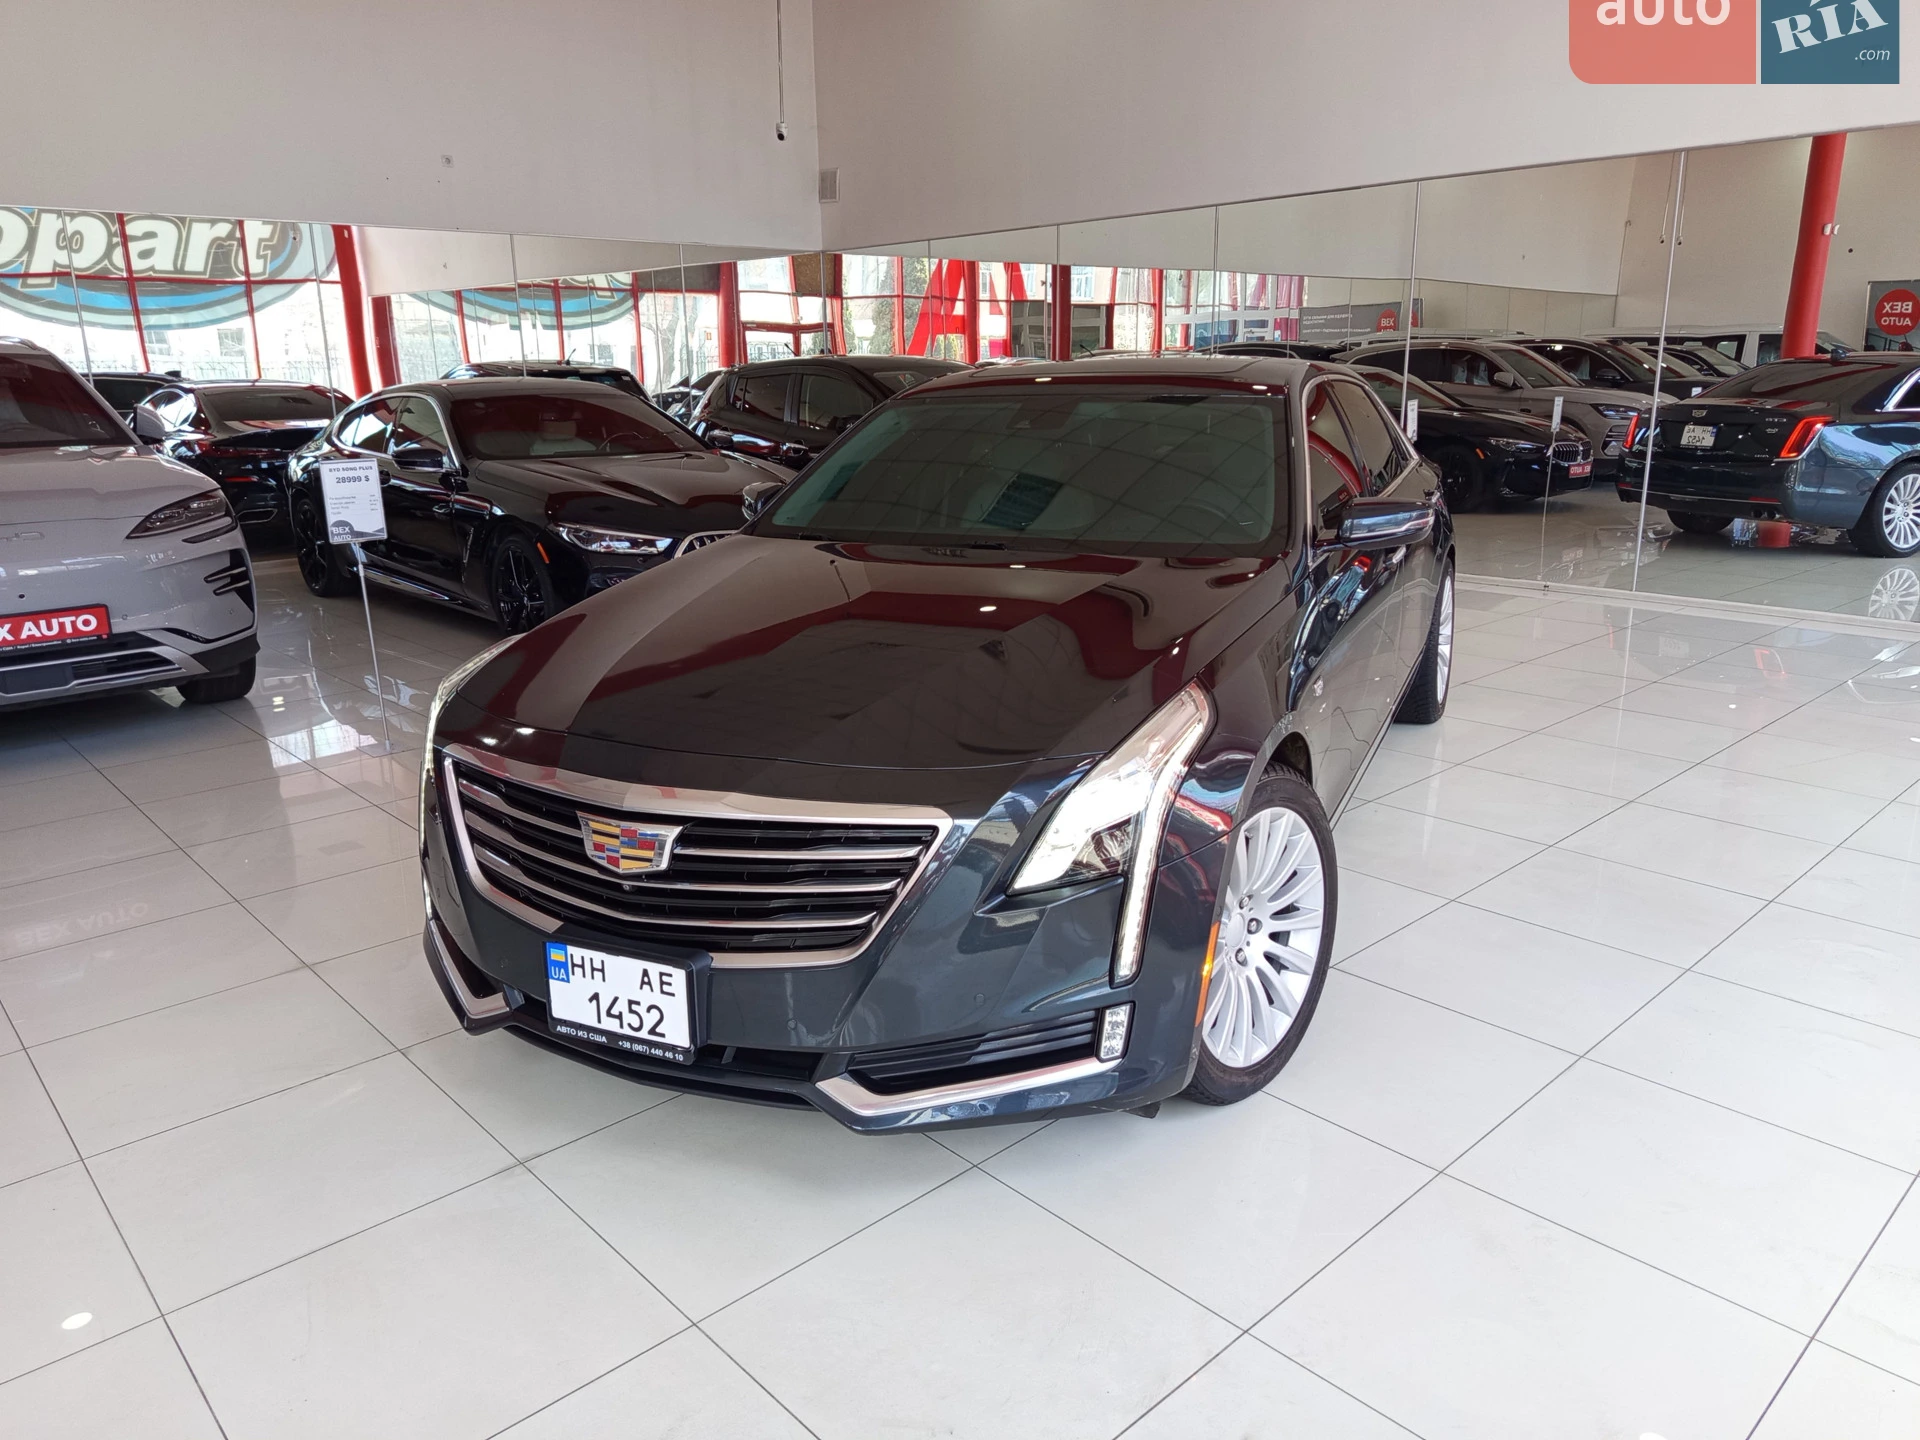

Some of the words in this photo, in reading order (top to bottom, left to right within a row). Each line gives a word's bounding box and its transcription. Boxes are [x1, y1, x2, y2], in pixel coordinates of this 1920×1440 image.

[1380, 317, 1395, 327] BEX
[336, 475, 362, 484] 28999
[333, 526, 351, 534] BEX
[20, 614, 98, 640] AUTO
[551, 966, 568, 980] UA
[570, 952, 606, 983] HH
[639, 968, 676, 997] AE
[588, 991, 666, 1039] 1452
[556, 1025, 577, 1036] АВТО
[577, 1030, 588, 1038] ИЗ
[589, 1033, 608, 1044] США
[618, 1040, 631, 1049] +38
[632, 1043, 650, 1055] (067)
[650, 1047, 664, 1057] 440
[664, 1051, 674, 1059] 46
[674, 1053, 684, 1061] 10
